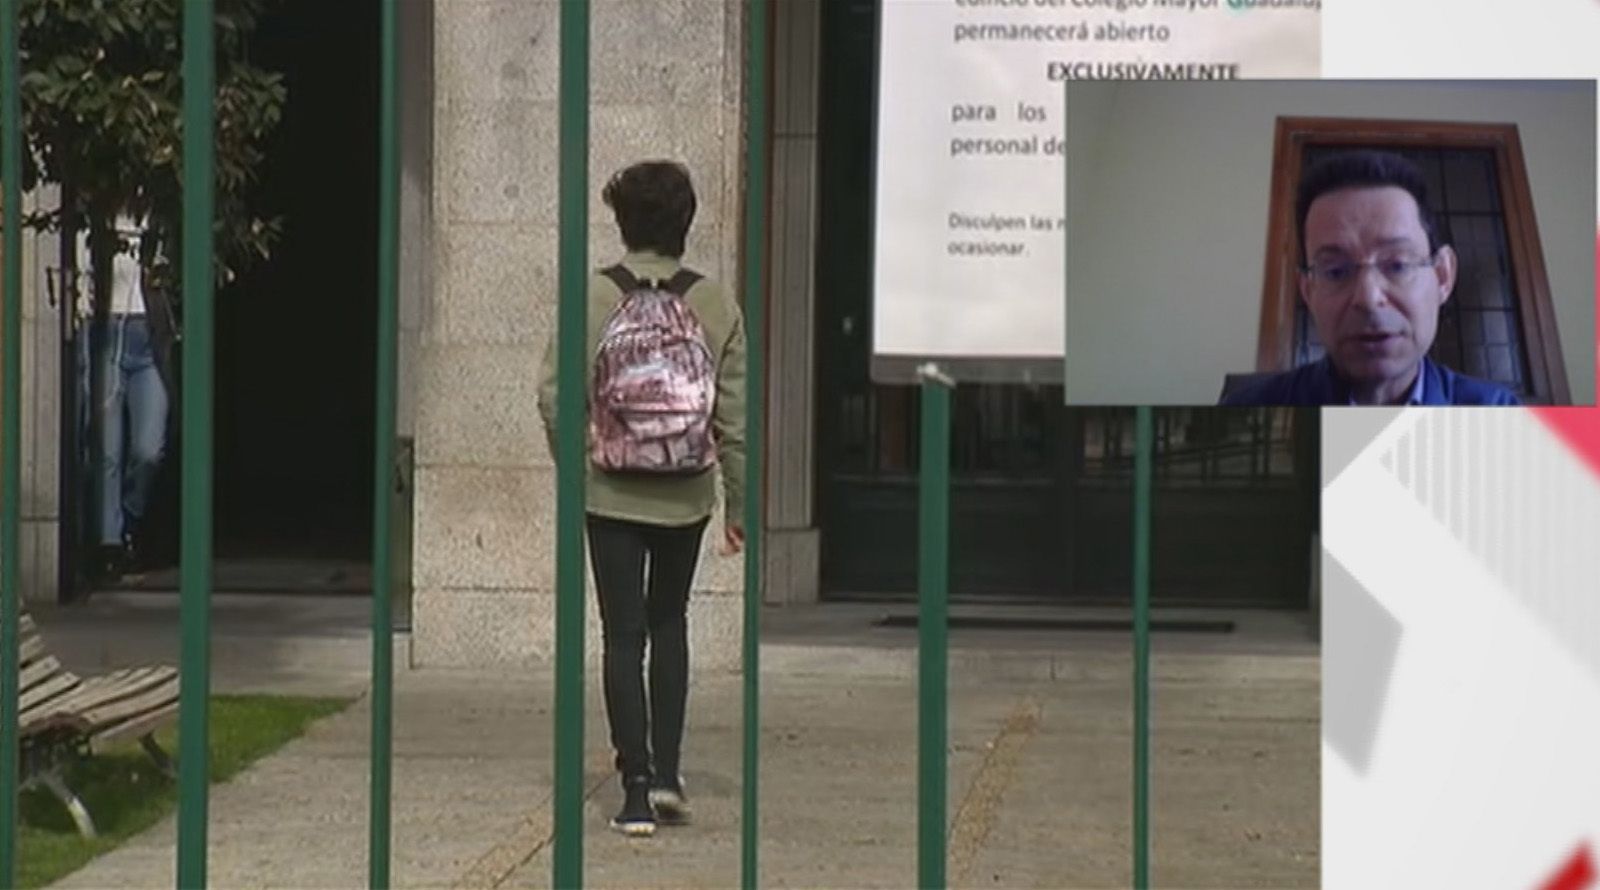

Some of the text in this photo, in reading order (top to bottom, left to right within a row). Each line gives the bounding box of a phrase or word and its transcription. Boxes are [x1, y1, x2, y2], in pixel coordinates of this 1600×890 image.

[953, 20, 1170, 42] permanecerá abierto
[1047, 62, 1240, 80] EXCLUSIVAMENTE
[951, 102, 1047, 122] para los
[950, 134, 1038, 156] personal
[947, 212, 1027, 232] Disculpen
[1030, 214, 1053, 230] las
